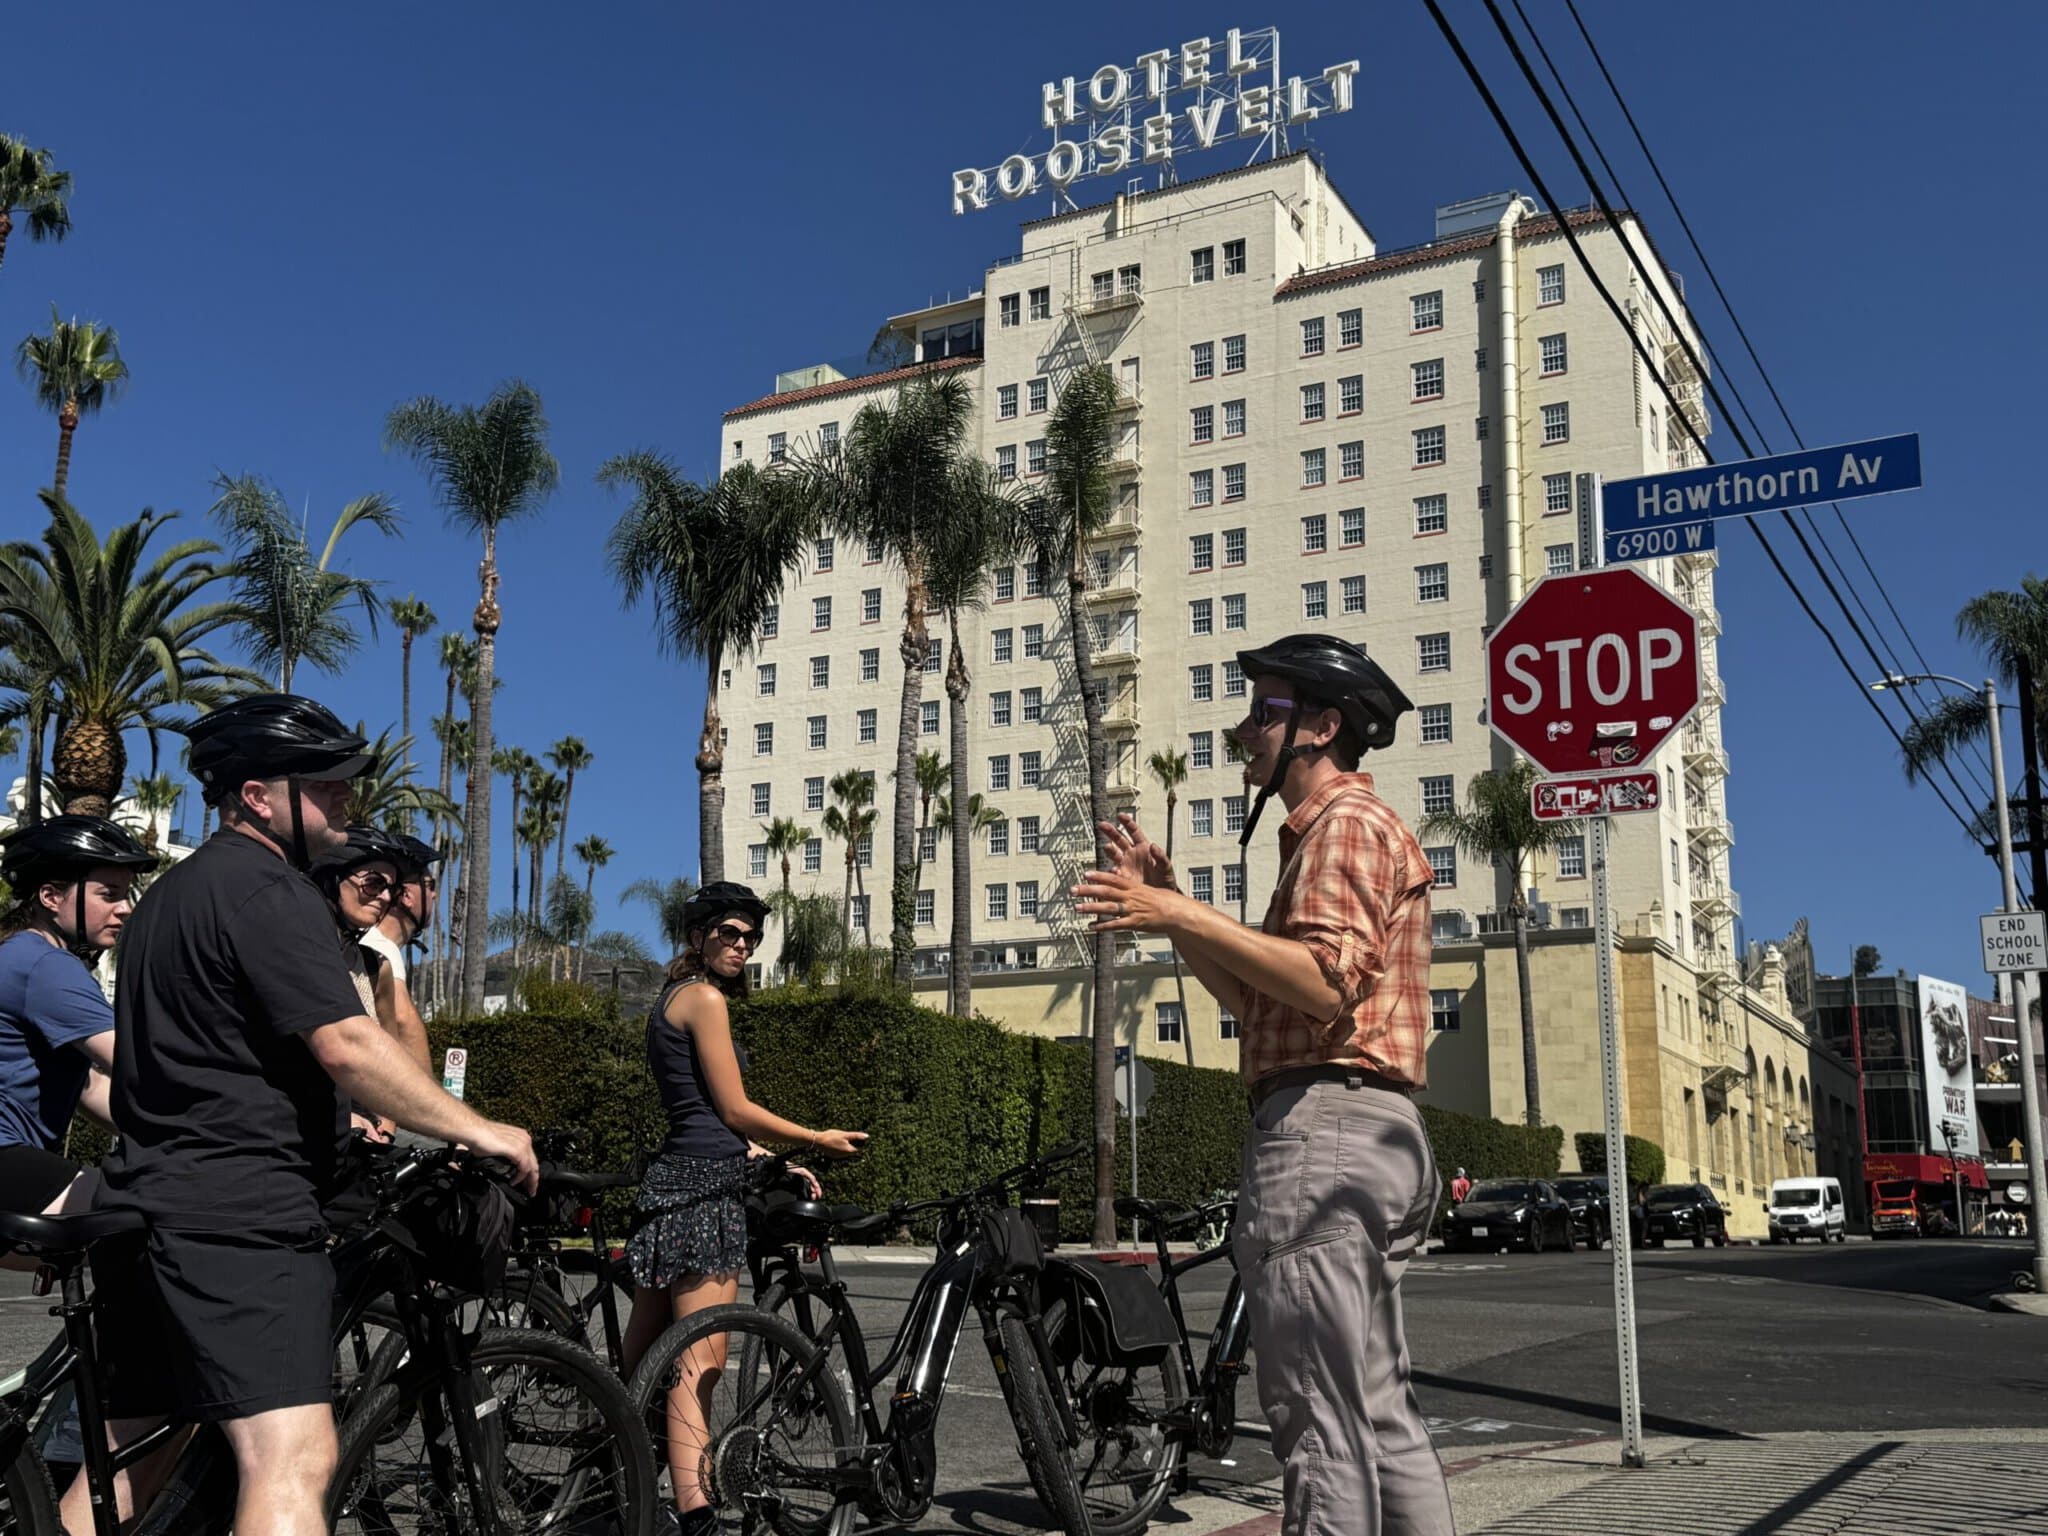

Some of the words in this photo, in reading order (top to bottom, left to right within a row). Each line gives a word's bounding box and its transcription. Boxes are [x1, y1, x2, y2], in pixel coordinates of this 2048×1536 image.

[1042, 27, 1256, 128] HOTEL
[952, 60, 1360, 215] ROOSEVELT
[1637, 465, 1819, 518] Hawthorn
[1837, 453, 1882, 488] Av
[1616, 529, 1677, 558] 6900
[1684, 526, 1703, 548] W
[1502, 627, 1683, 715] STOP
[1999, 918, 2025, 932] END
[1986, 934, 2042, 950] SCHOOL
[1997, 952, 2035, 967] ZONE
[1944, 1095, 1966, 1116] WAR
